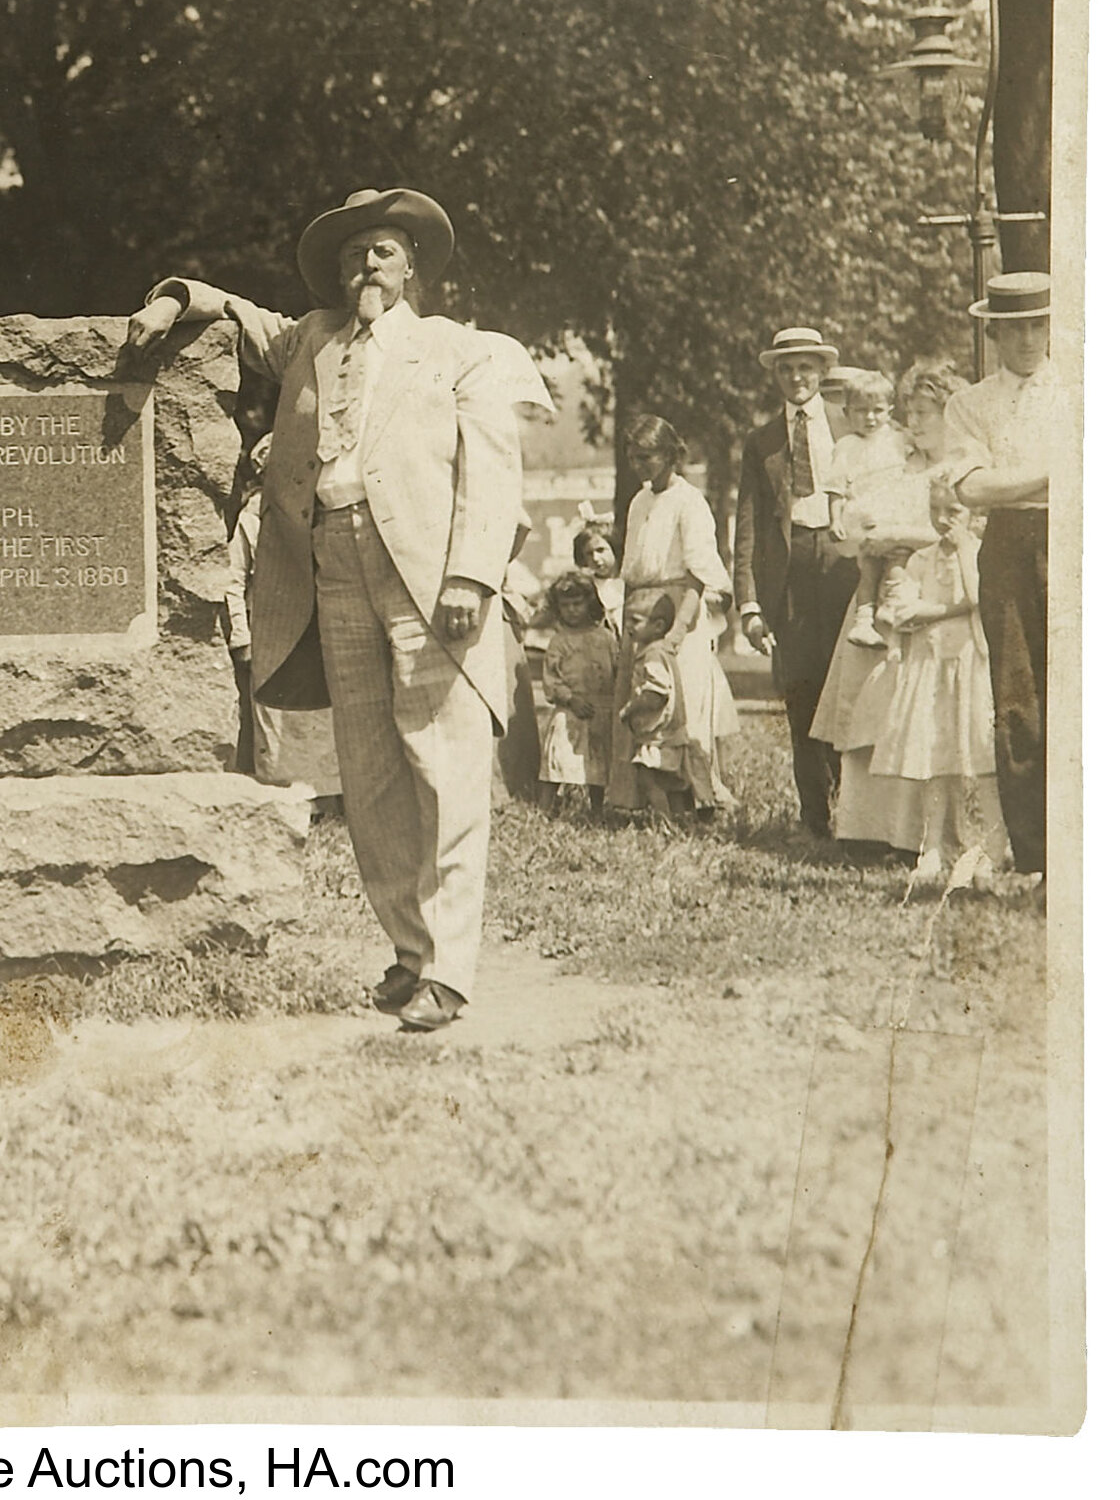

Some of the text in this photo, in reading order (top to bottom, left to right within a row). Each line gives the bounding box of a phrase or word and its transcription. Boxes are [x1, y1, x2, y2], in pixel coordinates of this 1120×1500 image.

[0, 416, 29, 436] BY
[36, 415, 80, 436] THE
[40, 535, 105, 557] FIRST
